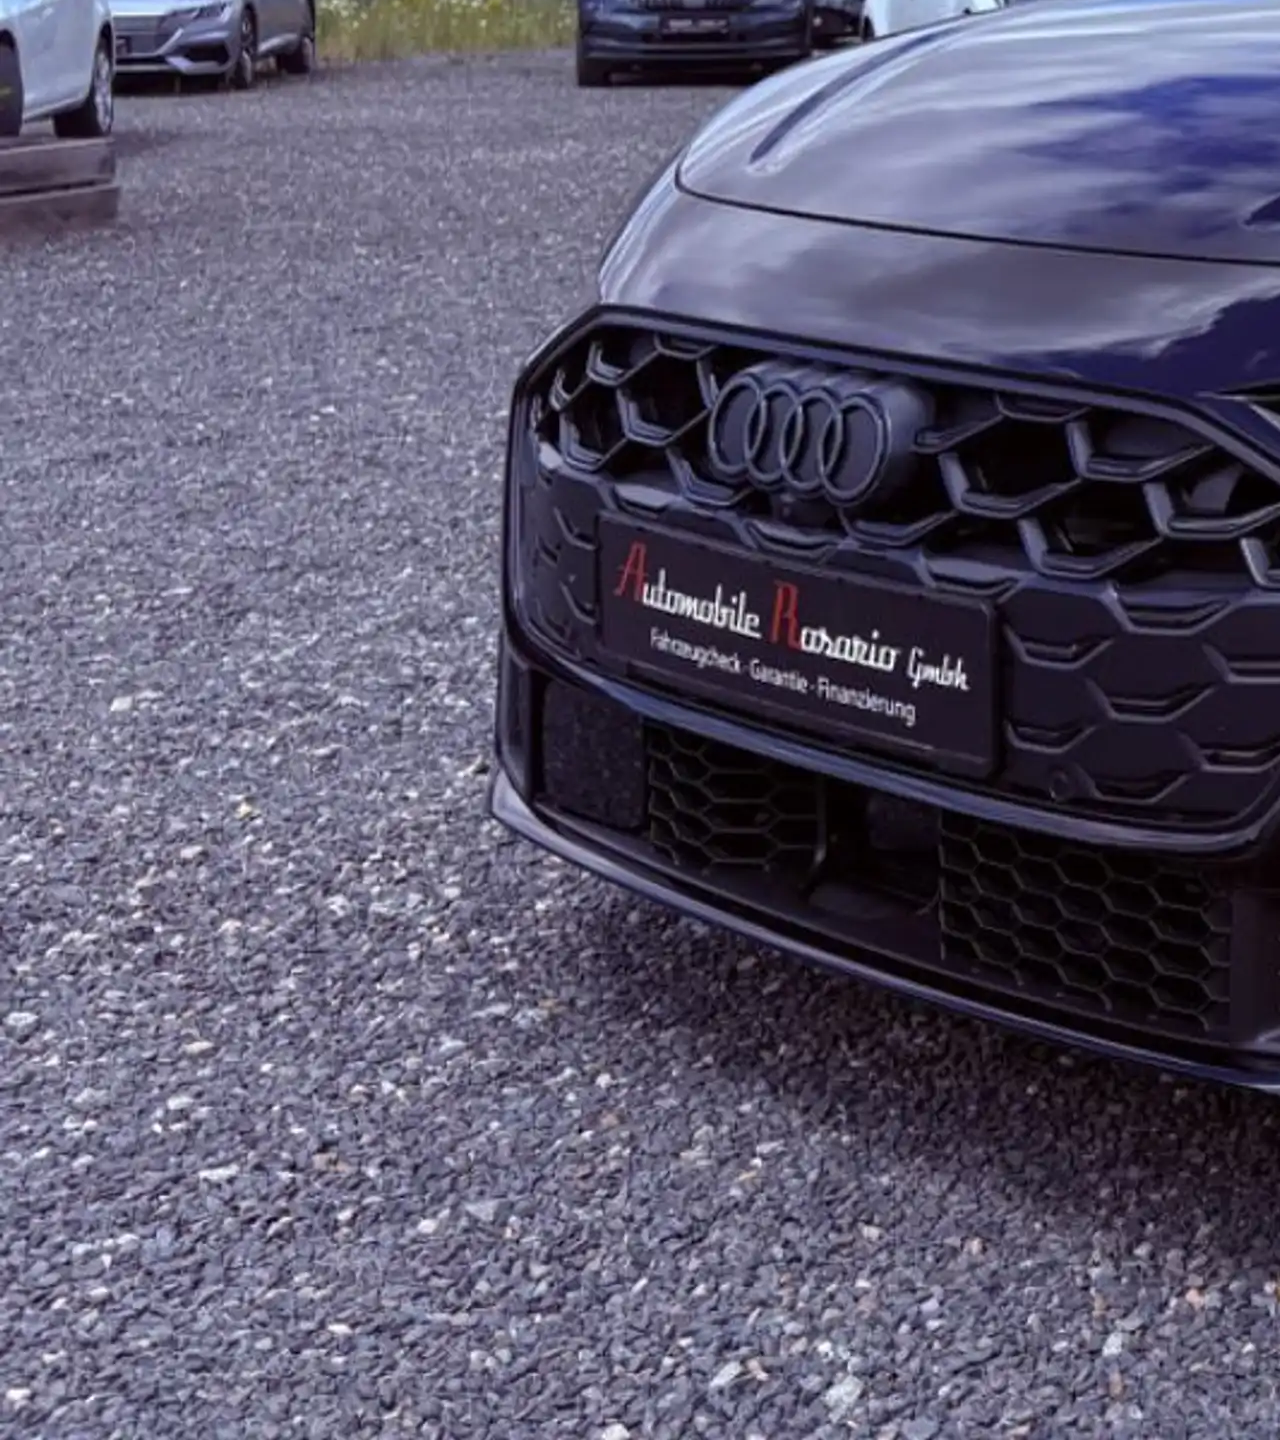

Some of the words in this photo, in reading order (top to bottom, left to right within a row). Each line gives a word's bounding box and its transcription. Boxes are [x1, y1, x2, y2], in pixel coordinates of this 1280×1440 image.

[614, 541, 762, 639] Automobile
[650, 627, 741, 673] Fahrzeugcheck
[749, 658, 808, 694] Garantie
[817, 677, 916, 727] Finanzierung
